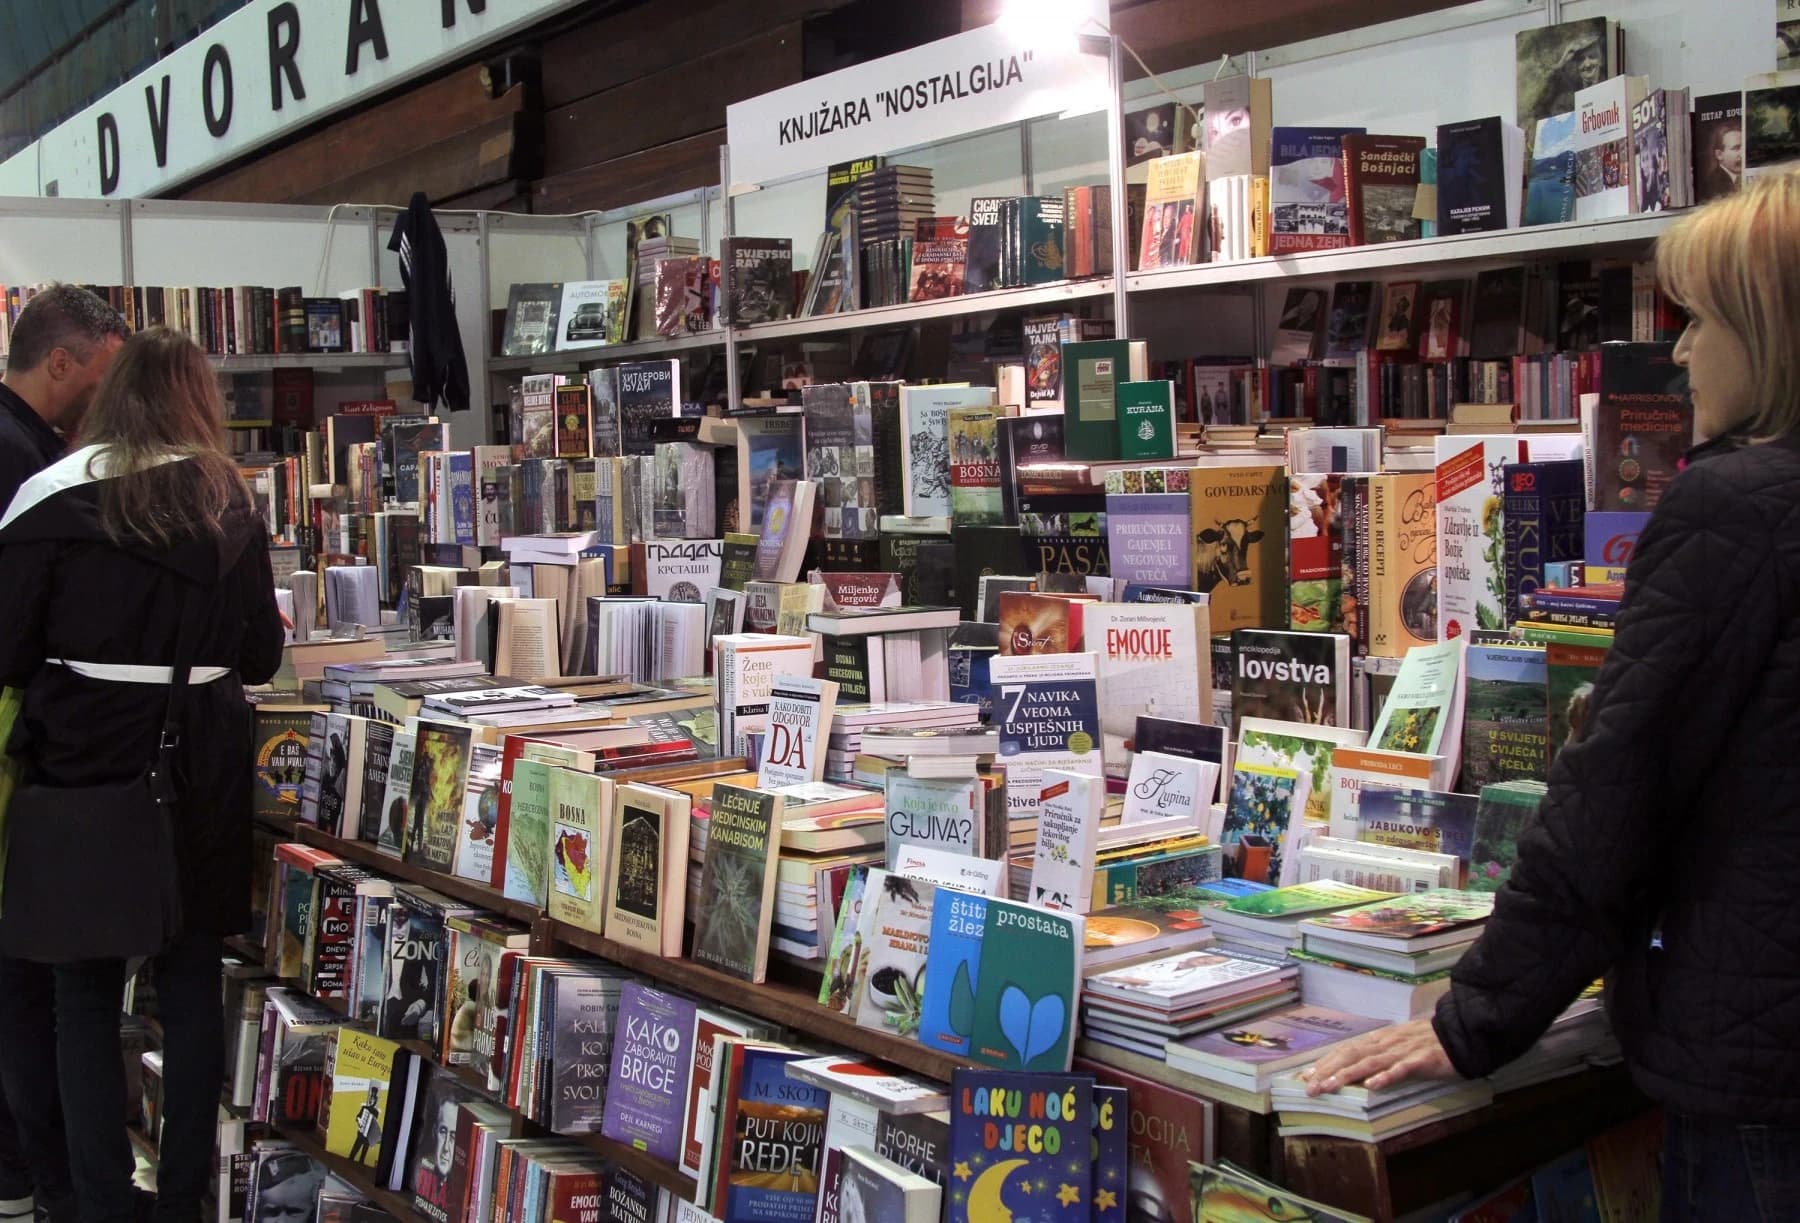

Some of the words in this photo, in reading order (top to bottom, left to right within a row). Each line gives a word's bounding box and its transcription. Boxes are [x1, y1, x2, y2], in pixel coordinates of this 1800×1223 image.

[97, 0, 488, 196] DVORA
[779, 98, 872, 147] KNJIŽARA
[876, 50, 1035, 118] "NOSTALGIJA"
[1632, 96, 1657, 130] 501
[1360, 150, 1416, 163] Sandžački
[1361, 162, 1416, 175] Bošnjaci
[1275, 236, 1314, 250] JEDNA
[736, 249, 792, 260] SVJETSKI
[736, 258, 761, 268] RAT
[1029, 333, 1057, 345] TAJNA
[622, 371, 671, 386] ХИТЛЕРОВИ
[622, 381, 650, 393] ЉУДИ
[1126, 405, 1165, 415] KURANA
[1620, 409, 1681, 420] Priručnik
[1620, 423, 1682, 433] medicine
[1375, 485, 1385, 524] BAKINI
[1115, 521, 1169, 535] PRIRUČNIK
[1169, 525, 1183, 535] ZA
[1444, 516, 1472, 541] Zdravlje
[1472, 523, 1479, 537] iz
[1127, 538, 1166, 551] GAJENJE
[1375, 529, 1385, 576] RECEPTI
[1445, 540, 1464, 561] Božje
[1038, 545, 1110, 575] PASA
[1122, 553, 1179, 566] NEGOVANJE
[657, 565, 710, 575] КРСТАШИ
[1135, 568, 1168, 581] CVEĆA
[1444, 564, 1471, 585] apoteke
[838, 585, 880, 596] Miljenko
[839, 594, 878, 605] Jergović
[1107, 628, 1173, 656] EMOCIJE
[1238, 645, 1281, 655] enciklopedija
[742, 656, 773, 672] Žene
[1238, 653, 1330, 685] lovstva
[742, 673, 767, 688] koje
[774, 701, 792, 713] KAKO
[1001, 685, 1027, 723] 7
[1027, 690, 1081, 703] NAVIKA
[1022, 706, 1072, 718] VEOMA
[772, 711, 811, 728] ODGOVOR
[1006, 719, 1084, 736] USPJEŠNIH
[766, 723, 807, 770] DA
[1027, 735, 1064, 749] LJUDI
[1134, 768, 1191, 809] Kupina
[721, 792, 760, 815] LEČENJE
[559, 803, 586, 825] BOSNA
[712, 810, 766, 834] MEDICINSKIM
[1043, 809, 1074, 824] Priručnik
[1074, 816, 1081, 824] za
[890, 811, 973, 845] GLJIVA?
[1043, 818, 1079, 836] sakupljanje
[1368, 819, 1430, 836] JABUKOVO
[710, 825, 764, 852] KANABISOM
[1041, 838, 1056, 850] bilja
[1042, 828, 1071, 845] lekovitog
[996, 908, 1070, 939] prostata
[580, 1004, 604, 1013] ROBIN
[626, 1015, 680, 1053] KAKO
[624, 1040, 677, 1069] ZABORAVITI
[620, 1055, 675, 1095] BRIGE
[753, 1082, 773, 1097] M.
[777, 1083, 818, 1102] SKOT
[962, 1087, 1022, 1119] LAKU
[1030, 1086, 1076, 1122] NOĆ
[745, 1117, 781, 1138] PUT
[886, 1125, 936, 1164] HORHE
[984, 1122, 1061, 1155] DJECO
[609, 1186, 647, 1221] BOŽANSKI
